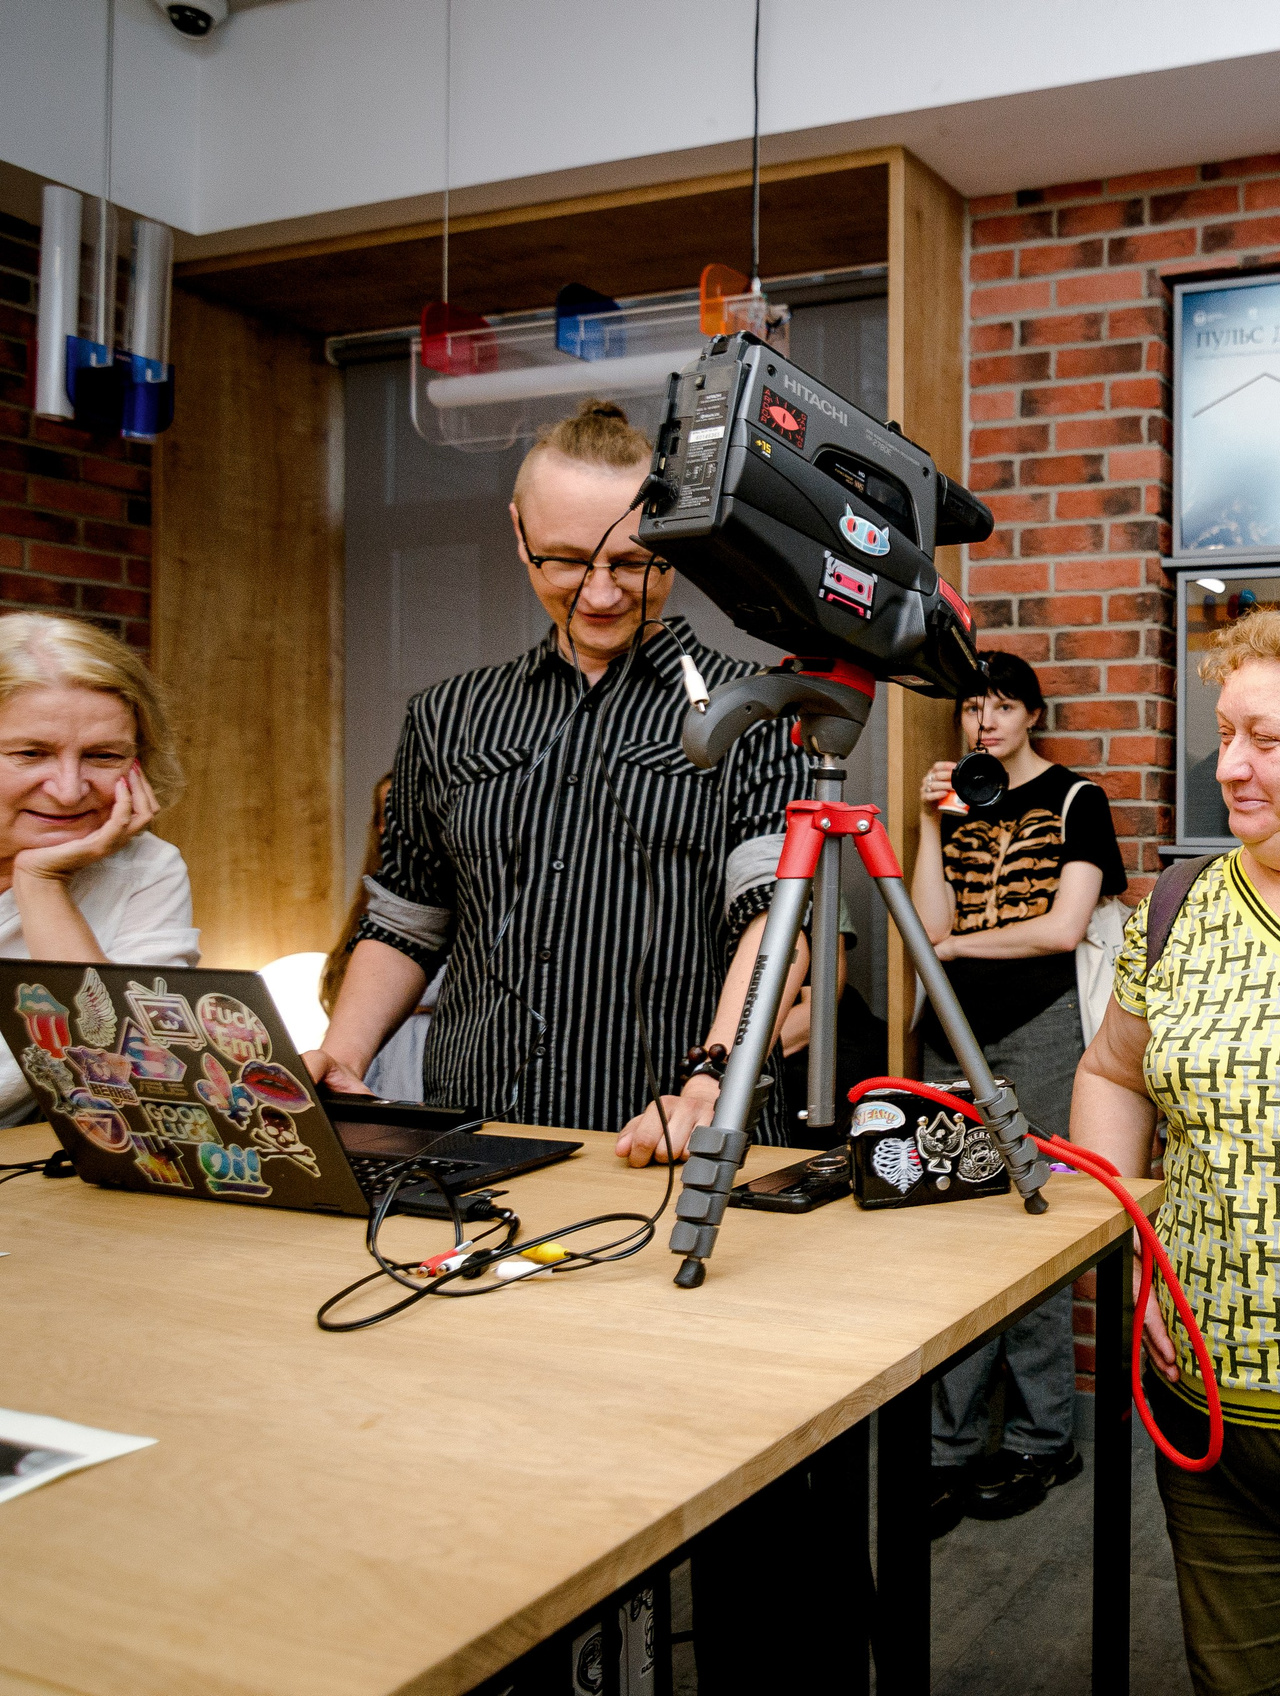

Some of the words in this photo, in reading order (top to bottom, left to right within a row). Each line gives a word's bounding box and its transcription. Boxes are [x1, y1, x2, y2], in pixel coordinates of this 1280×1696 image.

[1196, 326, 1265, 350] ПУЛЬС
[783, 374, 848, 427] HITACHI
[204, 998, 262, 1034] Fuck
[735, 954, 769, 1046] Manfrotto
[215, 1025, 266, 1061] Em!
[145, 1102, 208, 1123] GOOD
[157, 1119, 215, 1142] LUCK
